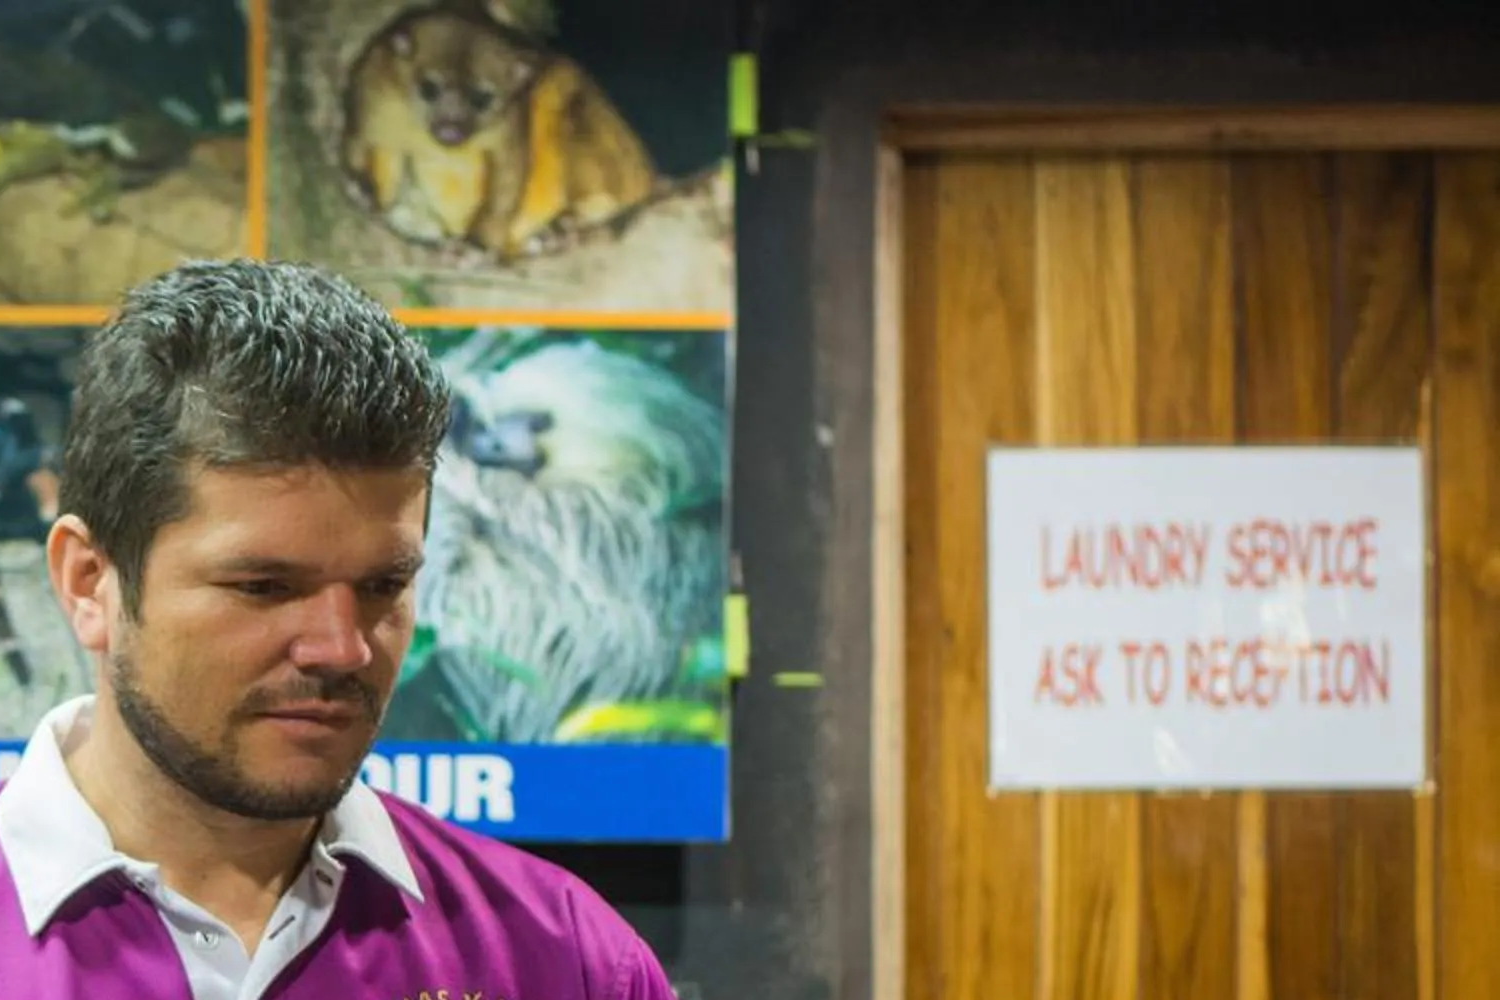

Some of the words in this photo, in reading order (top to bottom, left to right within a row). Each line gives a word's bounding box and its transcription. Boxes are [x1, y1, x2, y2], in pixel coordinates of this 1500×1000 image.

[1039, 519, 1209, 591] LAUNDRY
[1226, 517, 1379, 591] SERVICE
[1034, 642, 1104, 707] ASK
[1119, 641, 1172, 707] TO
